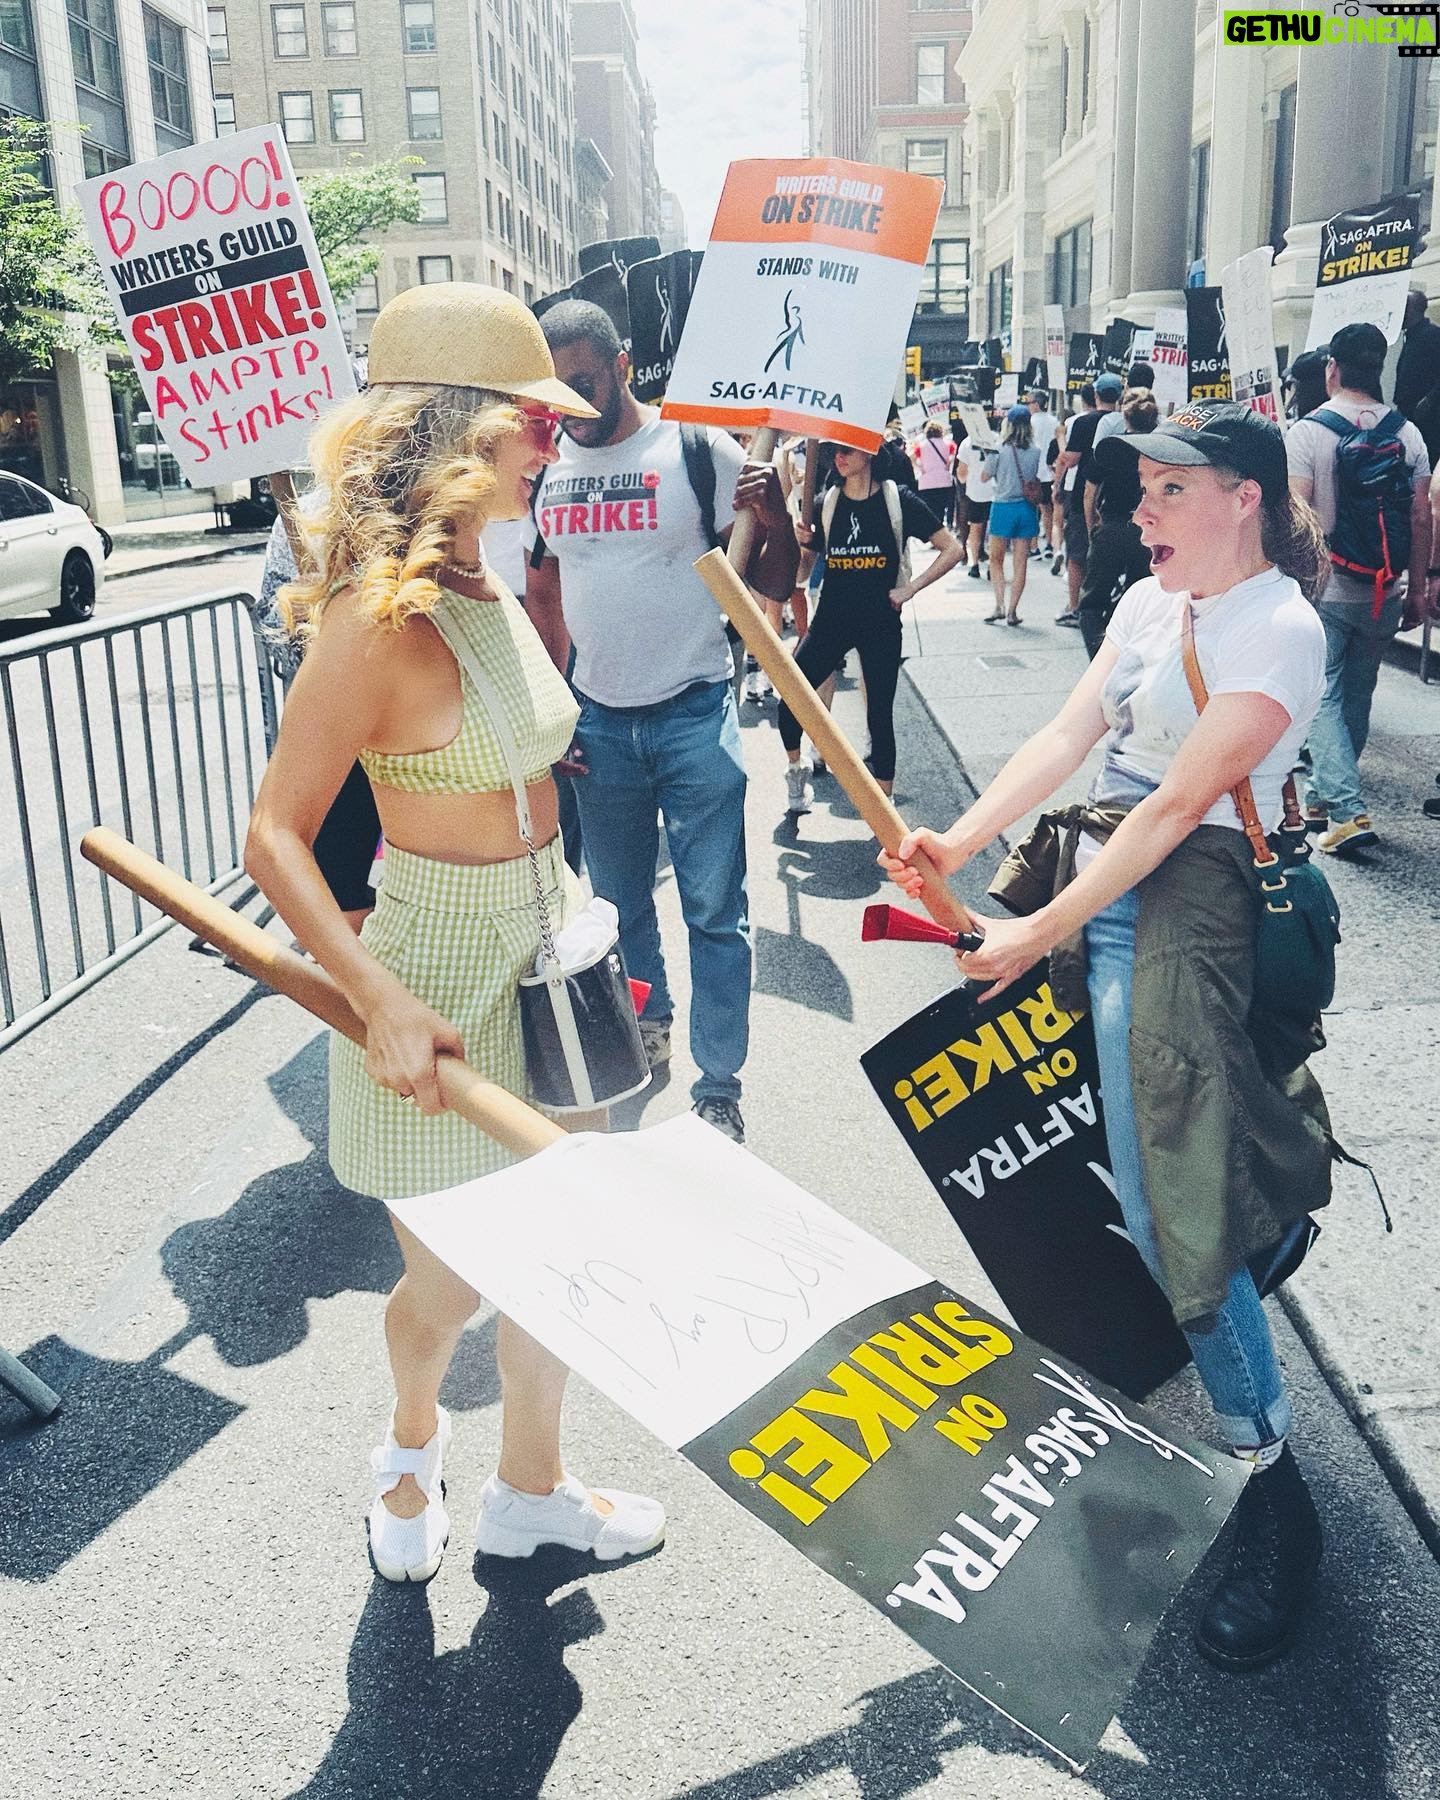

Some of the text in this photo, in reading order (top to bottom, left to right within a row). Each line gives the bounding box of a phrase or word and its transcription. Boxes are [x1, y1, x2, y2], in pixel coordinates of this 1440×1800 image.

[100, 140, 291, 259] BOOOO!
[775, 175, 884, 203] WRITERS GUILD
[762, 195, 884, 234] ON STRIKE
[110, 217, 298, 291] WRITERS GUILD
[1321, 246, 1409, 282] STRIKE!
[1355, 241, 1372, 254] ON
[194, 270, 223, 294] ON
[757, 257, 859, 284] STANDS WITH
[131, 270, 328, 371] STRIKE!
[156, 339, 319, 419] AMPTP
[545, 472, 645, 496] WRITERS GUIL
[587, 491, 603, 503] ON
[541, 500, 658, 538] STRIKE!
[828, 556, 887, 570] STRONG
[1022, 1048, 1077, 1096] ON
[728, 1300, 1014, 1526] STRIKE!
[934, 1393, 1008, 1457] ON
